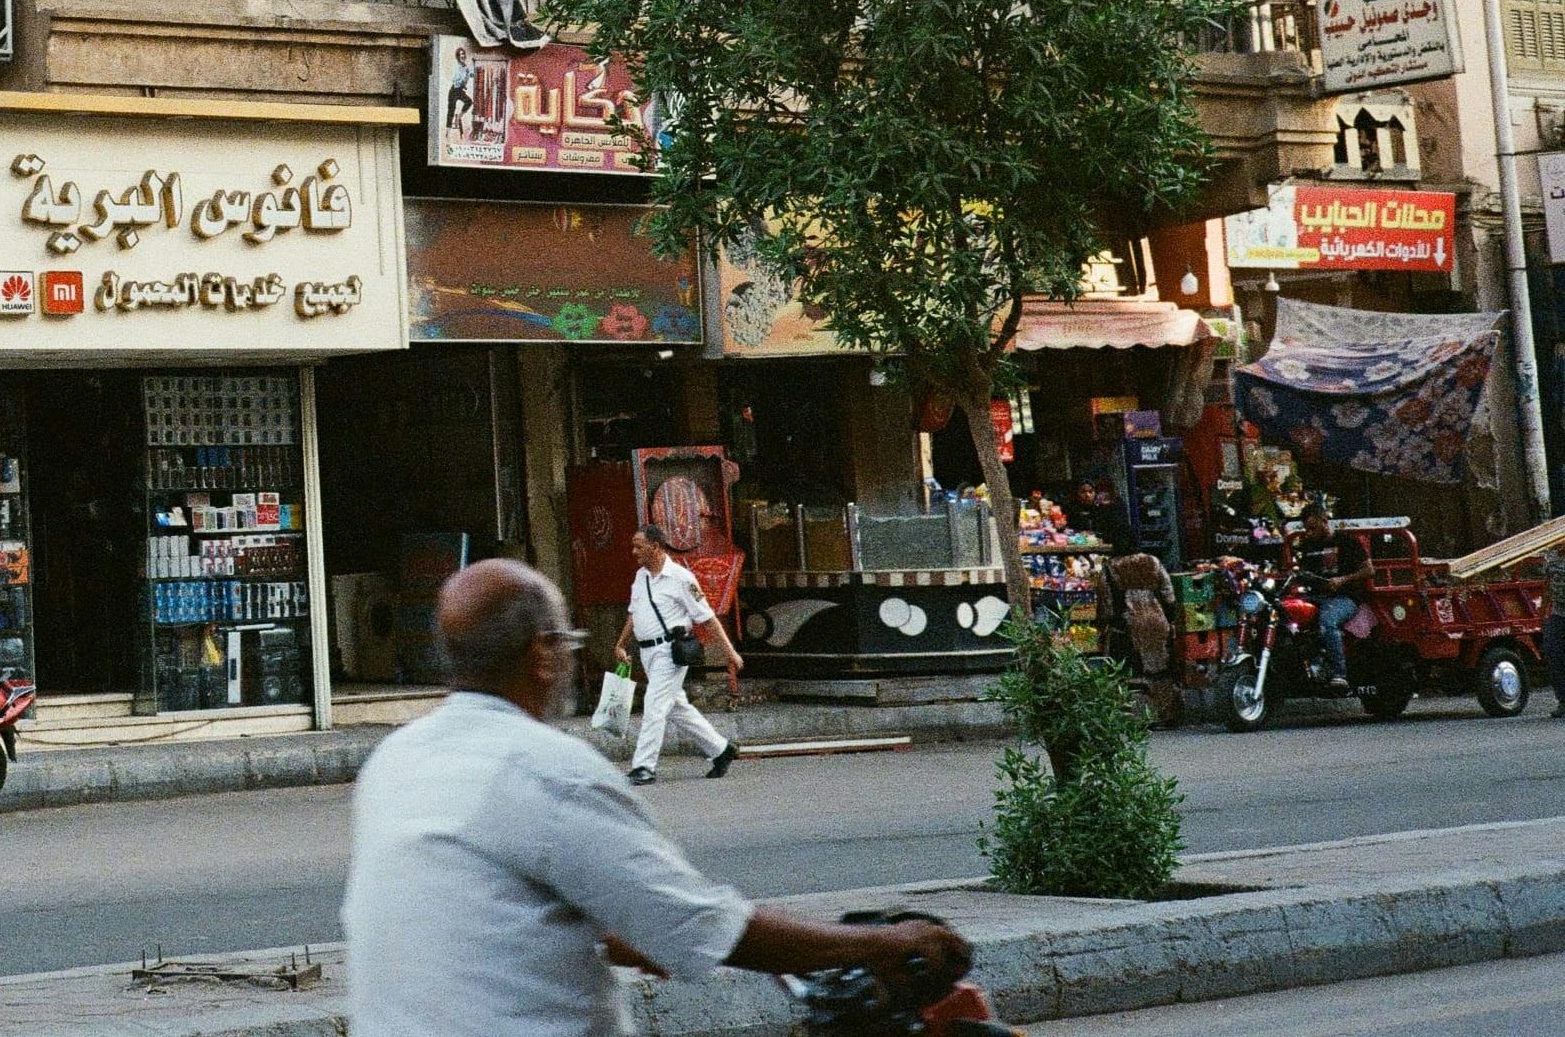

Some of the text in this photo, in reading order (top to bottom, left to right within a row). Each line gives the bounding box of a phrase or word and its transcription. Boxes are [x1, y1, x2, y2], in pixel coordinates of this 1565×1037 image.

[10, 154, 352, 254] فانوس البرية
[1301, 200, 1447, 233] محلات الحبايب
[1320, 237, 1385, 262] الكهربائية
[1, 303, 33, 311] HUAWEI
[94, 270, 199, 313] المحمول
[199, 271, 287, 313] خدمات
